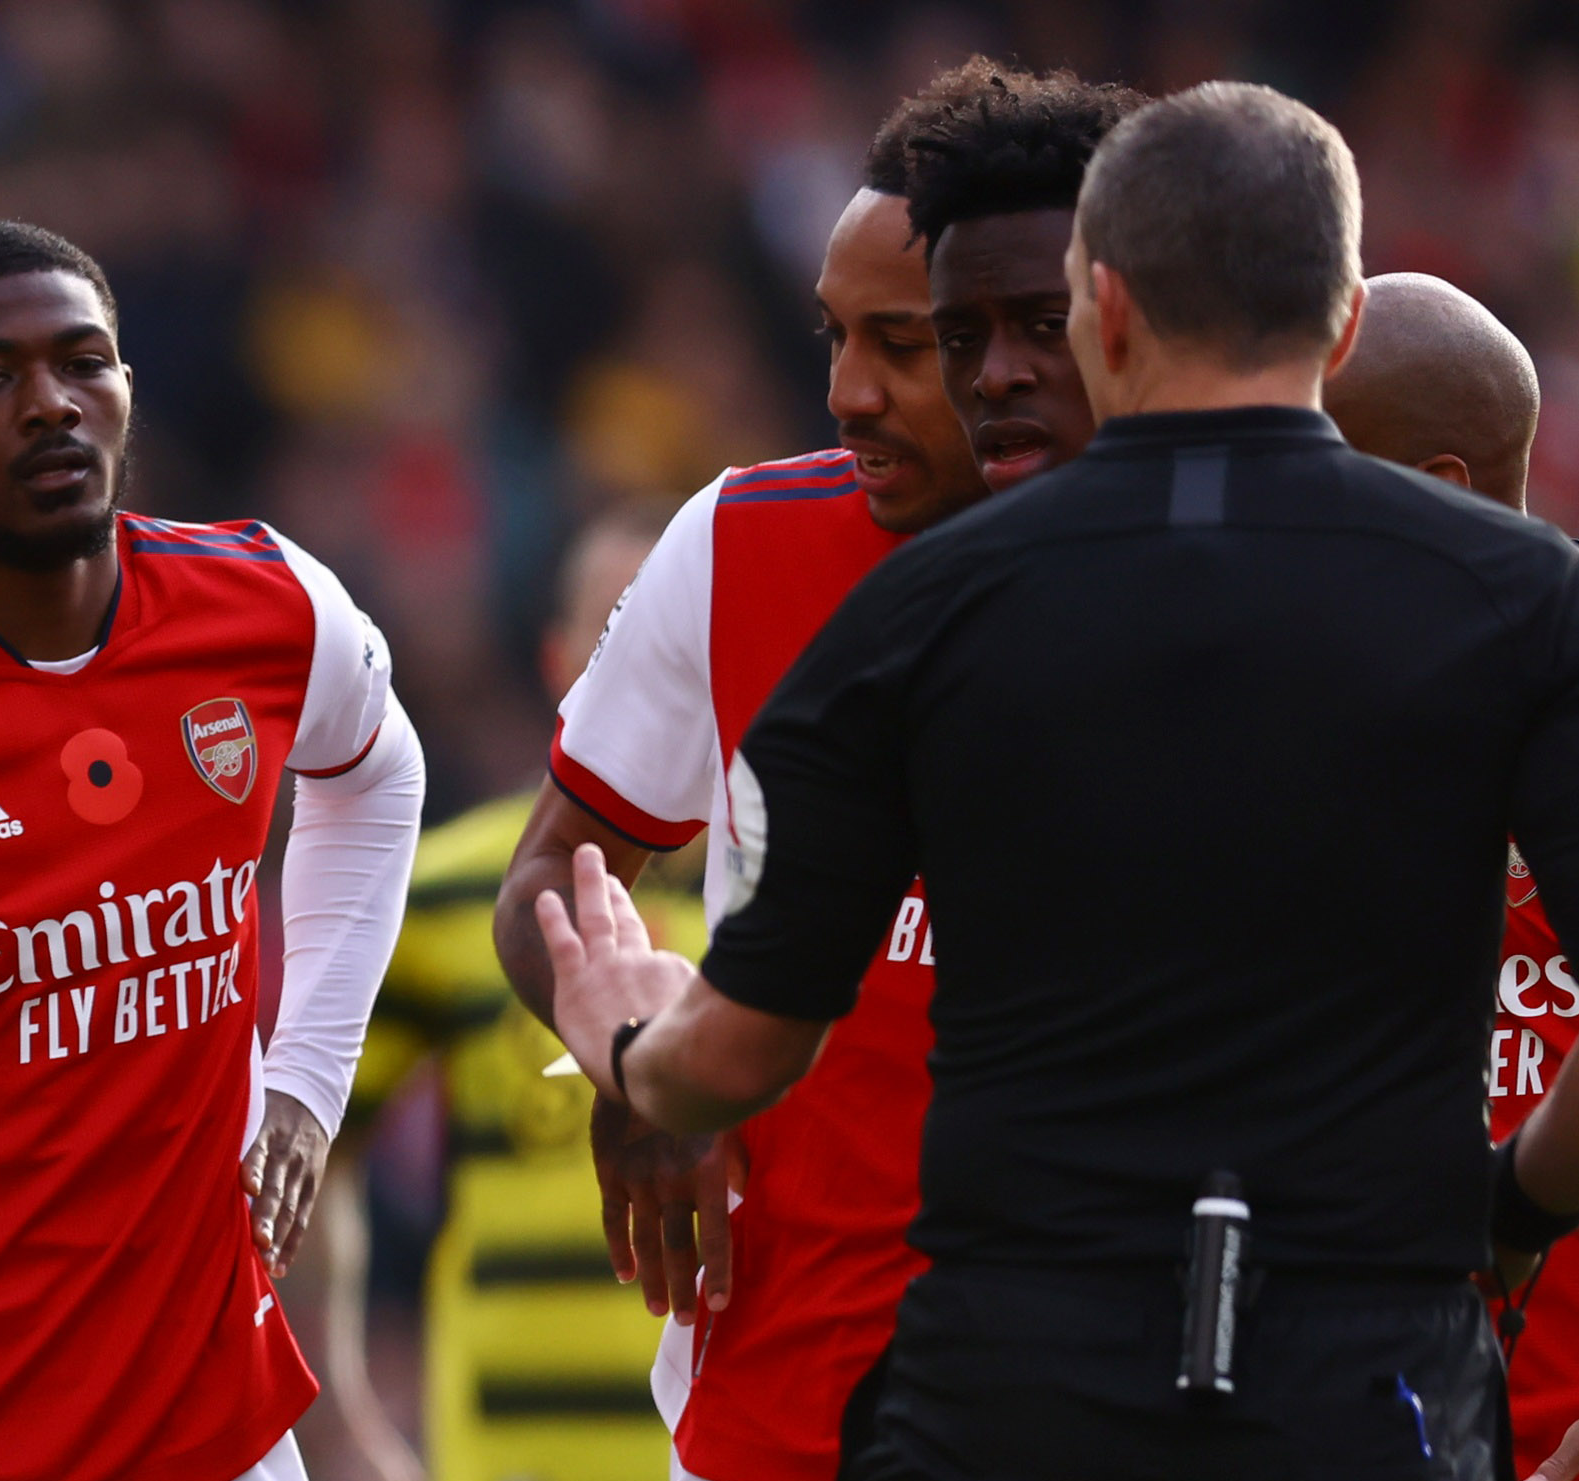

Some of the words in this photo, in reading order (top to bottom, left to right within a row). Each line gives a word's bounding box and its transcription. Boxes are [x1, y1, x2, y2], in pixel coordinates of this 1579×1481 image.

[193, 711, 242, 740] Arsenal
[20, 985, 96, 1064] FLY
[114, 940, 243, 1044] BETTER
[1495, 954, 1579, 1018] es
